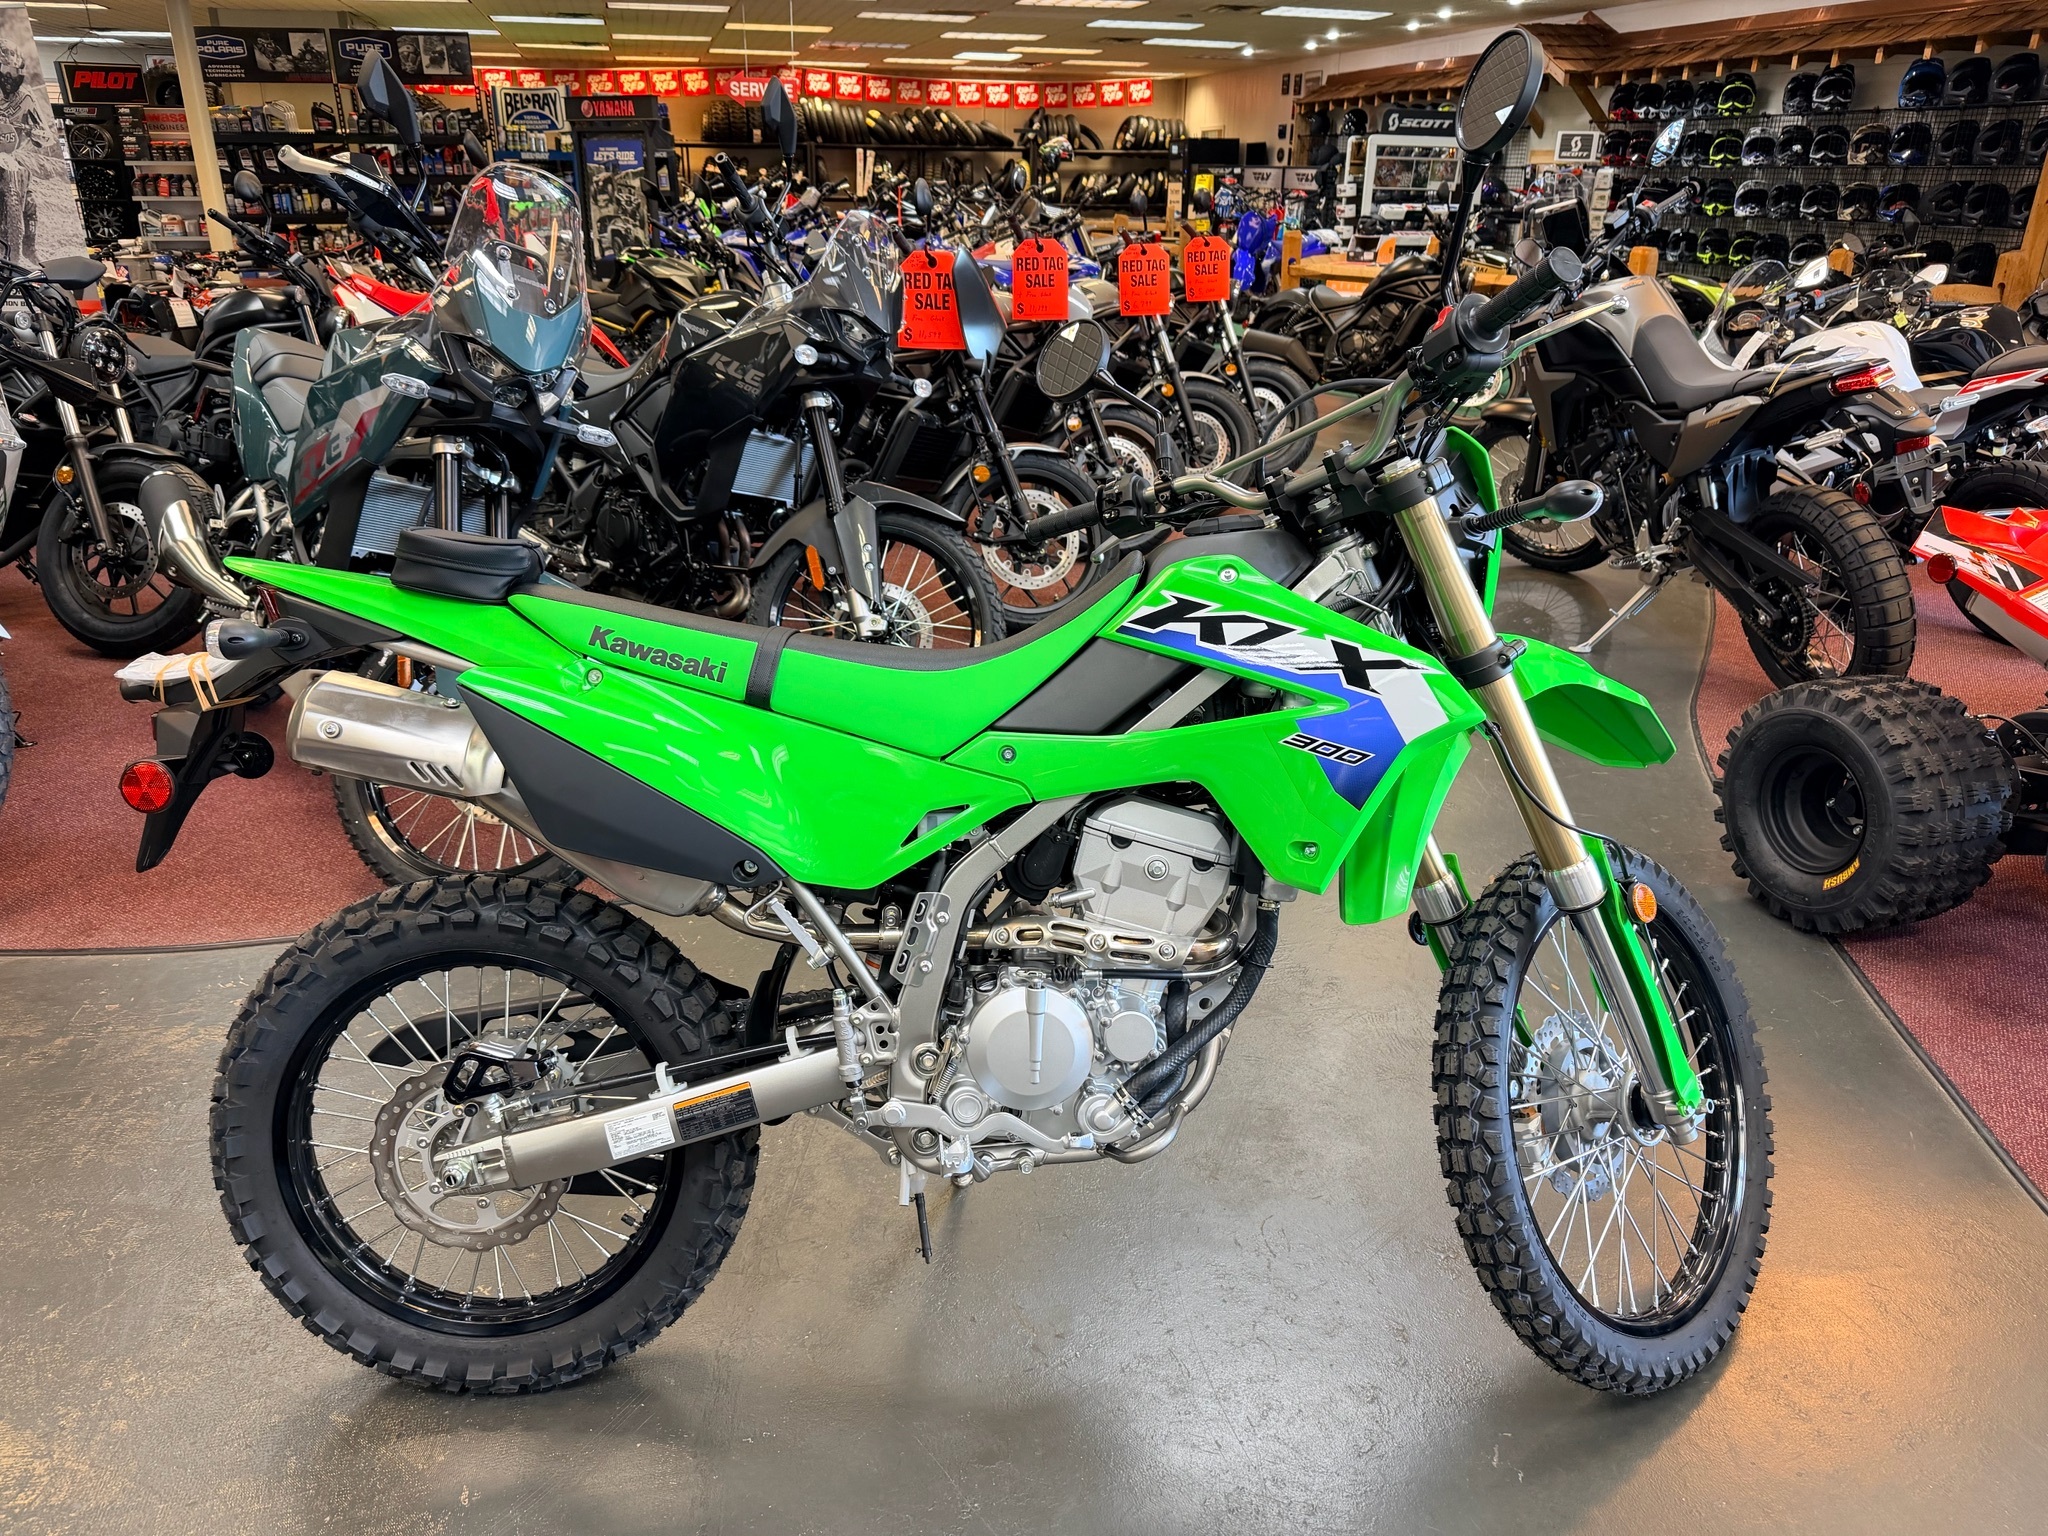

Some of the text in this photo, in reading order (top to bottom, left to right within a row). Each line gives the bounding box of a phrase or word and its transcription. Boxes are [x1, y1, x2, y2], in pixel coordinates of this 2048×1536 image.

[197, 46, 244, 54] POLARIS
[345, 43, 384, 53] PURE
[73, 71, 138, 89] PILOT
[587, 73, 608, 82] RIDE
[620, 72, 641, 82] RIDE
[652, 72, 673, 82] RIDE
[684, 71, 704, 81] RIDE
[807, 73, 828, 82] RIDE
[837, 76, 858, 85] RIDE
[591, 81, 613, 93] RED
[622, 80, 646, 94] RED
[655, 80, 677, 92] RED
[687, 79, 709, 93] RED
[729, 81, 794, 99] SERVE
[809, 80, 831, 92] RED
[839, 83, 861, 96] RED
[868, 79, 889, 89] RIDE
[898, 81, 919, 91] RIDE
[928, 83, 948, 92] RIDE
[958, 84, 977, 93] RIDE
[987, 85, 1006, 94] RIDE
[1016, 85, 1035, 94] RIDE
[1045, 86, 1064, 95] RIDE
[1073, 85, 1092, 95] RIDE
[1101, 83, 1121, 93] RIDE
[1130, 82, 1149, 92] RIDE
[869, 86, 891, 99] RED
[899, 88, 921, 101] RED
[930, 90, 951, 103] RED
[960, 91, 981, 104] RED
[988, 92, 1009, 105] RED
[1017, 92, 1039, 105] RED
[1046, 92, 1067, 105] RED
[1075, 92, 1096, 104] RED
[1103, 90, 1123, 103] RED
[1131, 89, 1151, 102] RED
[593, 99, 636, 116] YAMAHA
[149, 123, 185, 131] ENGINES
[1400, 118, 1453, 129] SCOTT
[616, 151, 635, 160] RIDE
[1187, 250, 1226, 262] RED TAG
[1016, 256, 1064, 271] RED TAG
[1122, 259, 1166, 273] RED TAG
[1194, 263, 1218, 276] SALE
[904, 272, 953, 290] RED TA
[1025, 273, 1055, 288] SALE
[1130, 274, 1157, 287] SALE
[1189, 287, 1195, 297] $
[914, 293, 950, 310] SALE
[1123, 300, 1131, 311] $
[1016, 302, 1025, 315] $
[904, 327, 913, 342] $
[707, 352, 766, 386] KLE
[1120, 599, 1429, 695] KLX
[588, 625, 728, 683] Kawasaki
[1282, 733, 1371, 765] 300
[1822, 856, 1861, 891] AMBUSH
